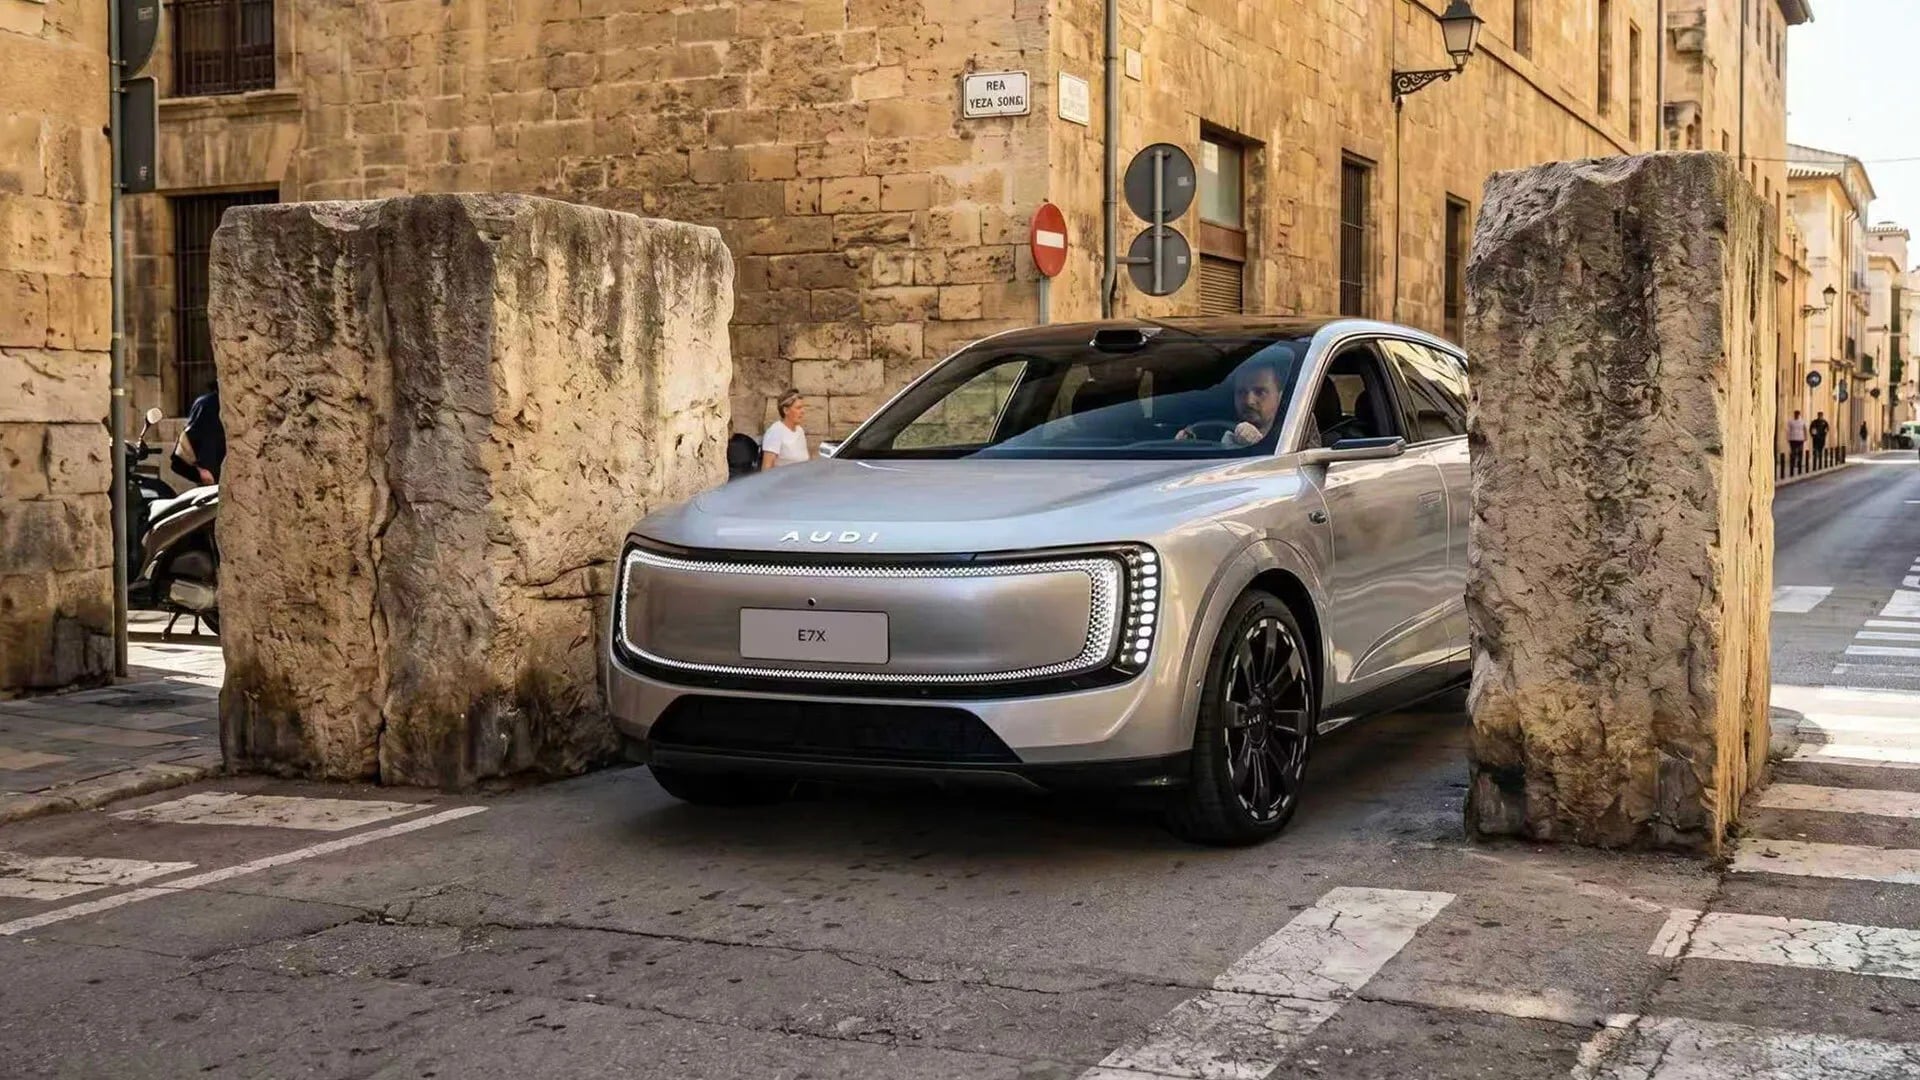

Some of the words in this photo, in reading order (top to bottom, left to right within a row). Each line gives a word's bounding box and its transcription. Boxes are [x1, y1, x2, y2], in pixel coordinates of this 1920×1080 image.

[986, 80, 1006, 91] REA
[970, 97, 993, 109] YEZA
[780, 530, 879, 543] AUDI
[798, 629, 826, 642] E7X
